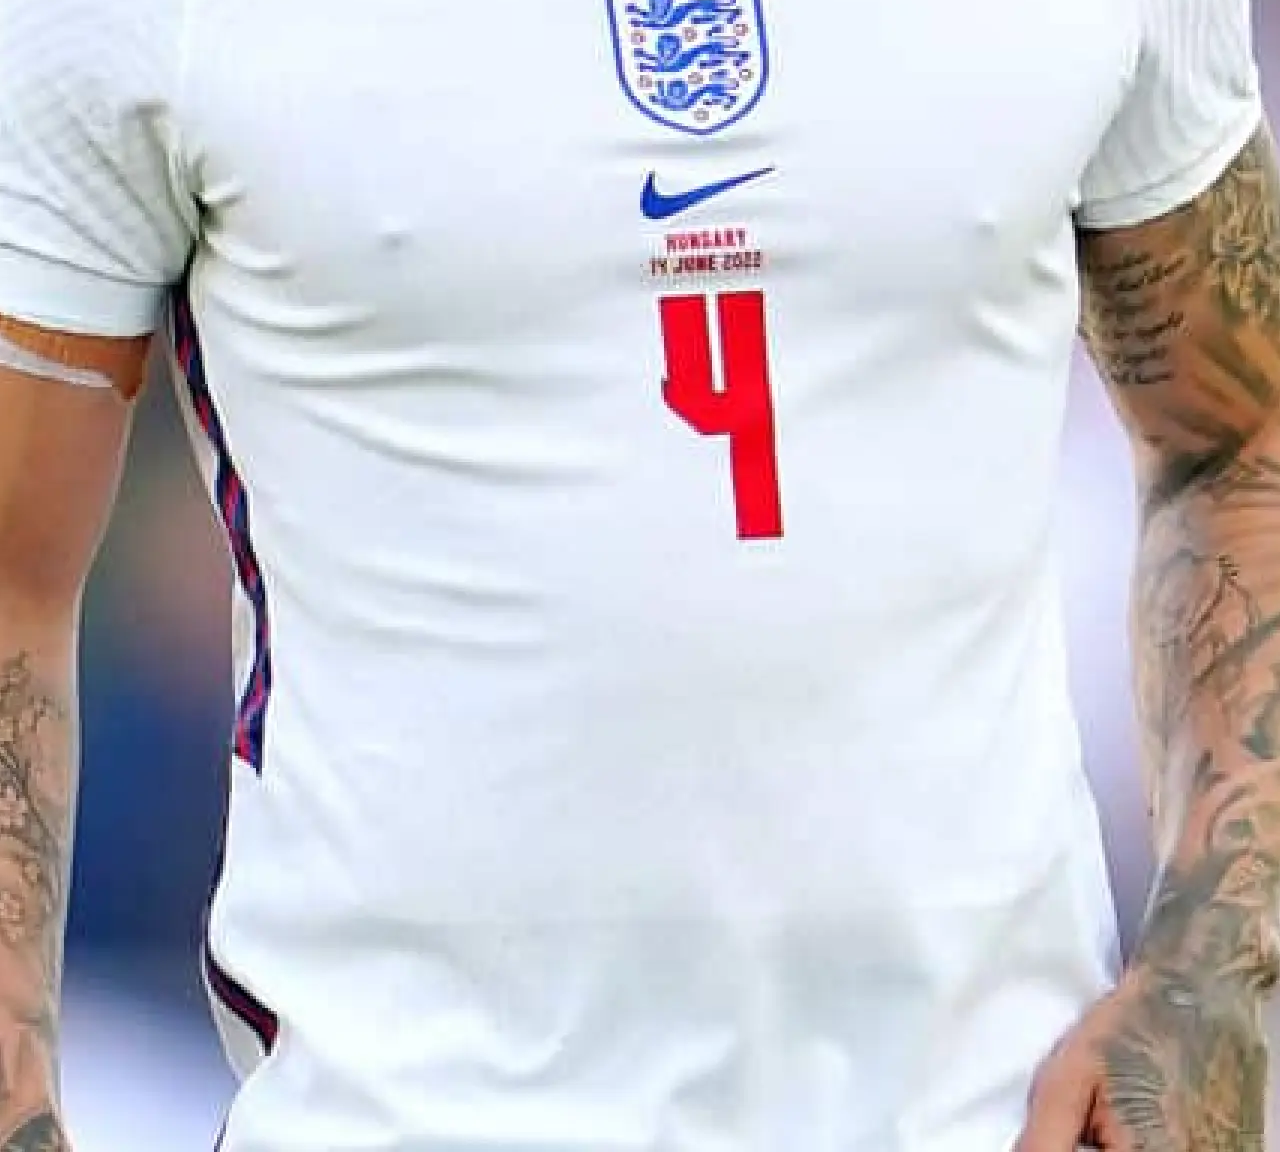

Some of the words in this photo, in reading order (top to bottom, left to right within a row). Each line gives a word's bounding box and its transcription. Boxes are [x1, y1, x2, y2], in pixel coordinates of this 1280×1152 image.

[664, 228, 746, 252] HUNGARY
[673, 253, 717, 274] JUNE
[721, 249, 762, 271] 2022
[658, 290, 784, 539] 4
